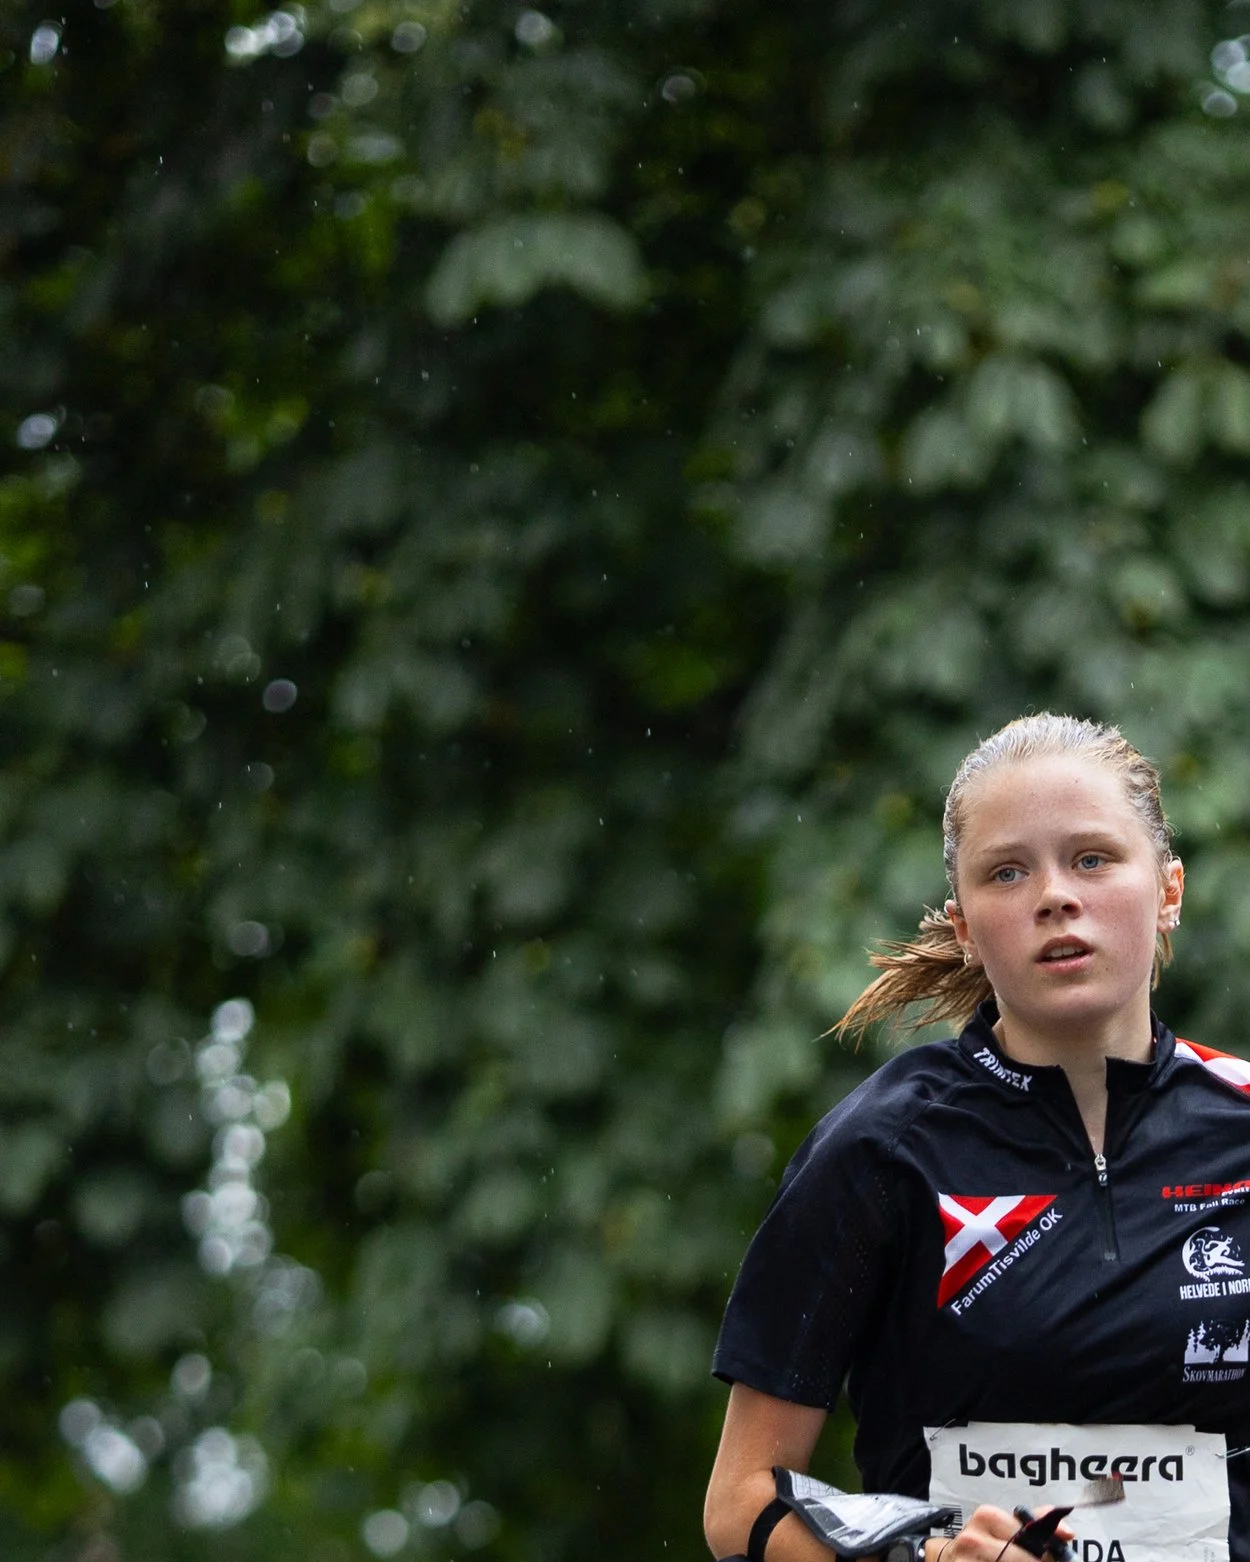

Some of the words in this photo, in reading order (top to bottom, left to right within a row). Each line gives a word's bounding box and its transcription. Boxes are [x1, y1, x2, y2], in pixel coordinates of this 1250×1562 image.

[1174, 1203, 1197, 1213] MTB
[950, 1228, 1041, 1316] FarumTisvilde
[1039, 1207, 1064, 1232] OK
[1180, 1282, 1221, 1300] HELVEDE
[1222, 1281, 1227, 1296] I
[959, 1443, 1184, 1487] bagheera
